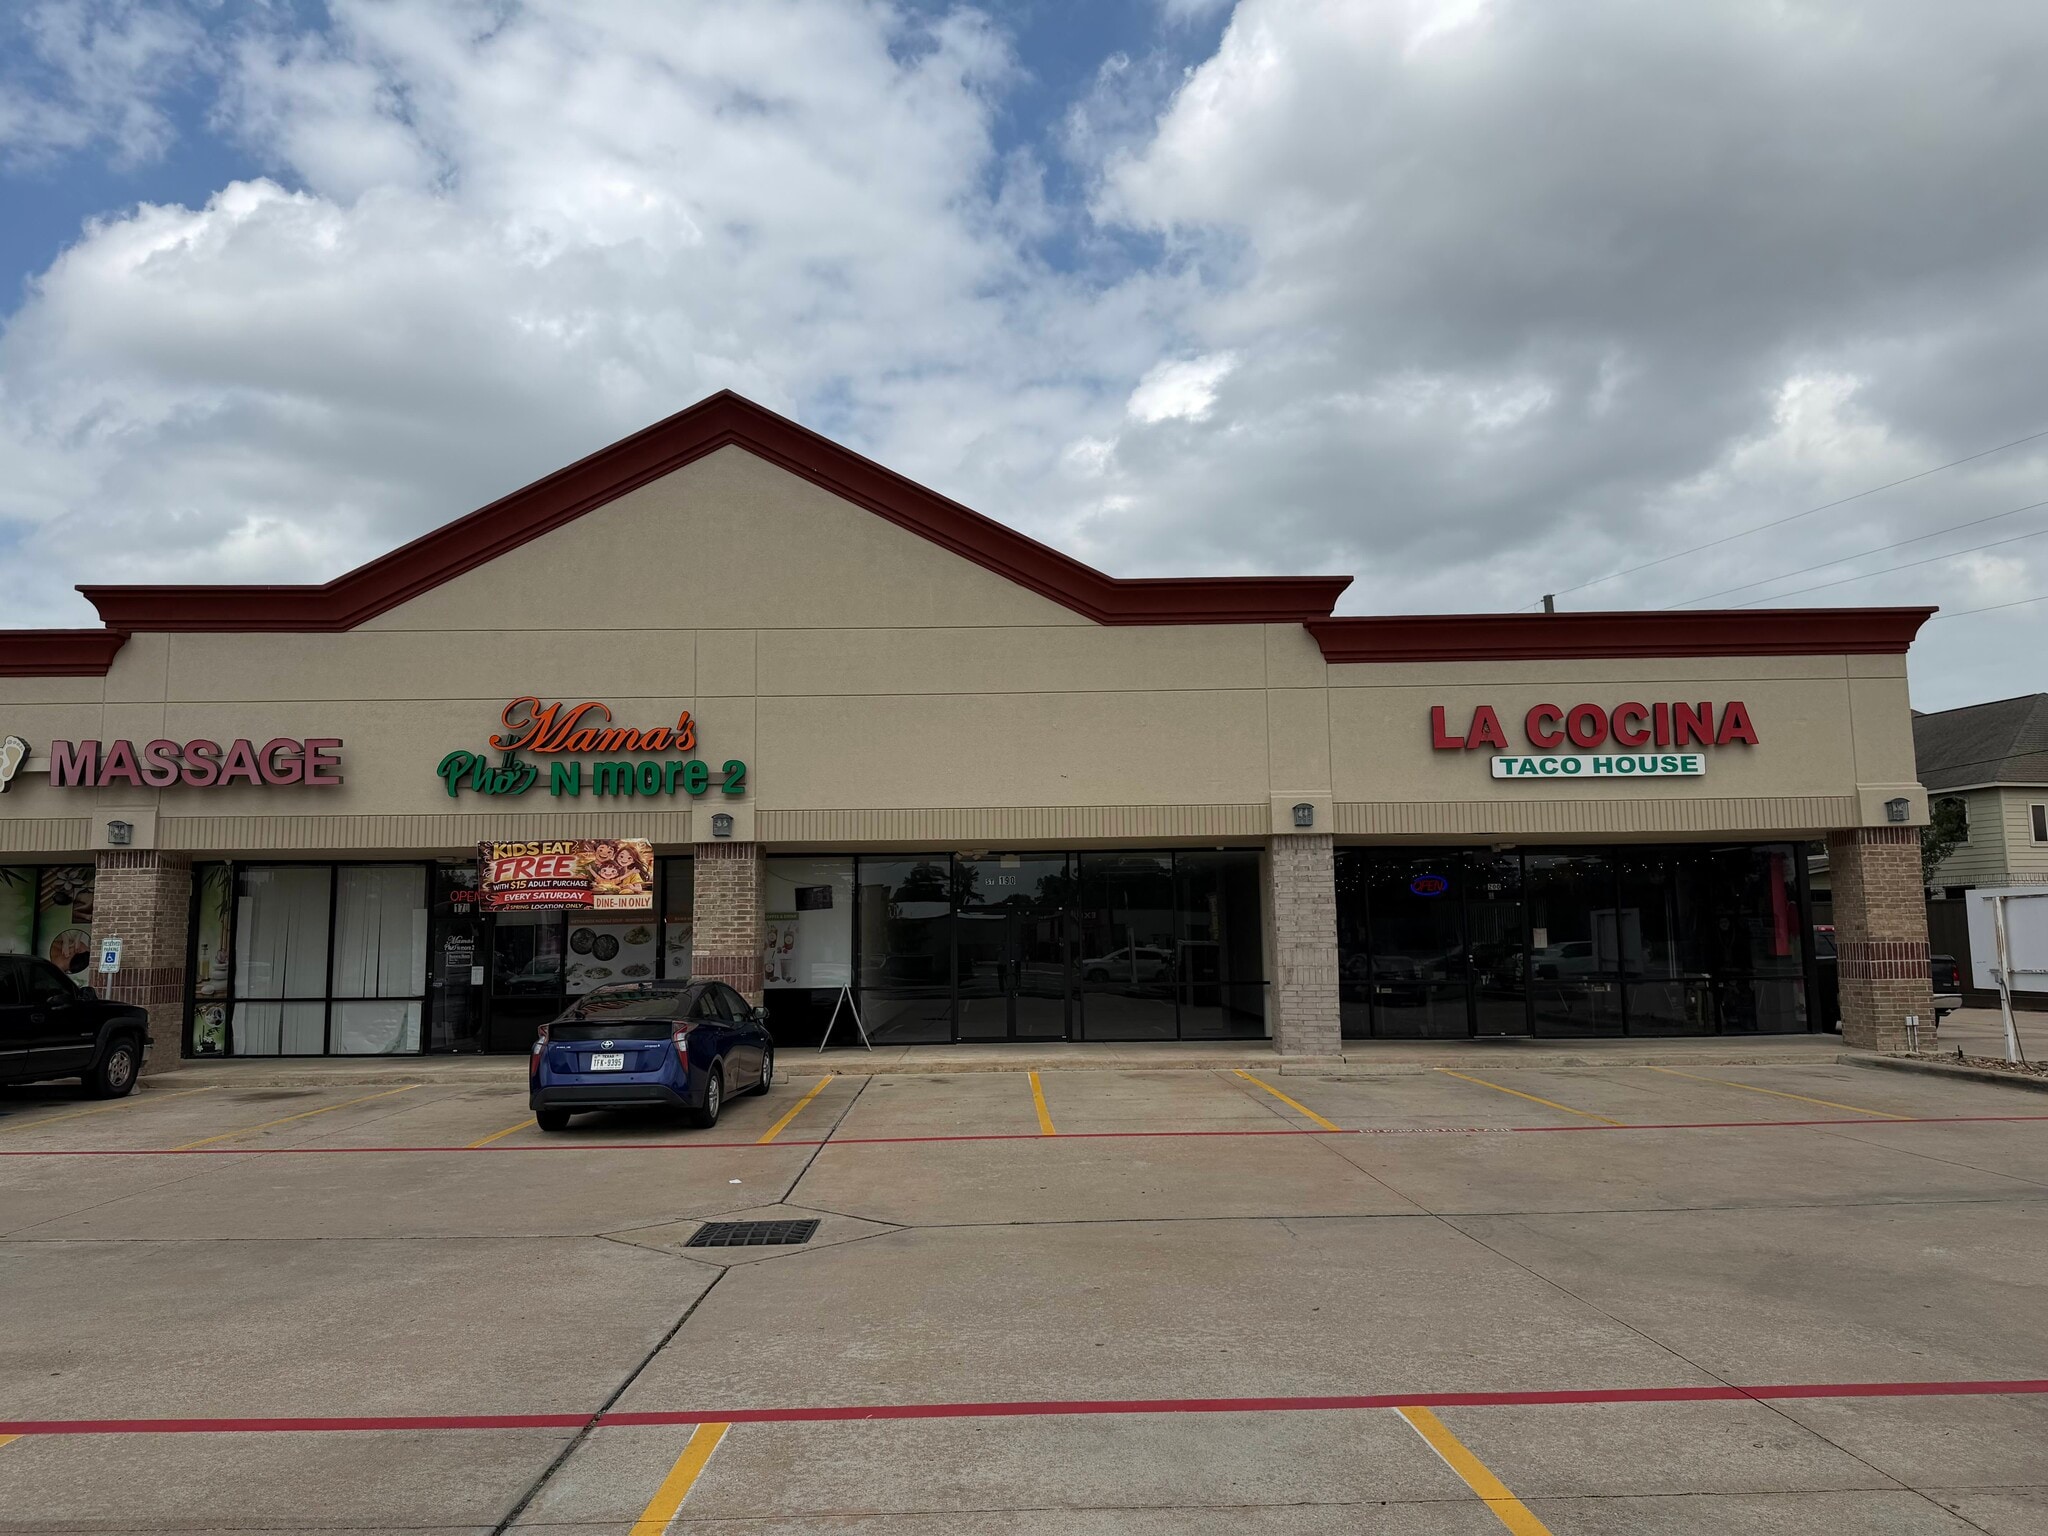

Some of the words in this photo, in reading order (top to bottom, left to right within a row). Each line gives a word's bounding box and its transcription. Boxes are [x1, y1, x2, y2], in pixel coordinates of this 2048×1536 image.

[489, 696, 697, 753] Mama's
[1431, 705, 1508, 749] LA
[1525, 701, 1759, 748] COCINA
[49, 738, 343, 787] MASSAGE
[1499, 757, 1582, 776] TACO
[1593, 755, 1699, 774] HOUSE
[550, 761, 580, 796] N
[593, 759, 708, 796] more
[721, 759, 746, 794] 2
[493, 842, 539, 860] KIDS
[542, 842, 574, 855] EAT
[494, 855, 575, 882] FREE
[493, 882, 509, 891] WITH
[510, 881, 527, 890] $15
[528, 880, 551, 888] ADULT
[1413, 880, 1444, 891] OPEN
[450, 890, 480, 902] OPEN
[504, 892, 531, 901] EVERY
[532, 891, 585, 900] SATURDAY
[596, 897, 627, 908] DINE-IN
[628, 896, 650, 907] ONLY
